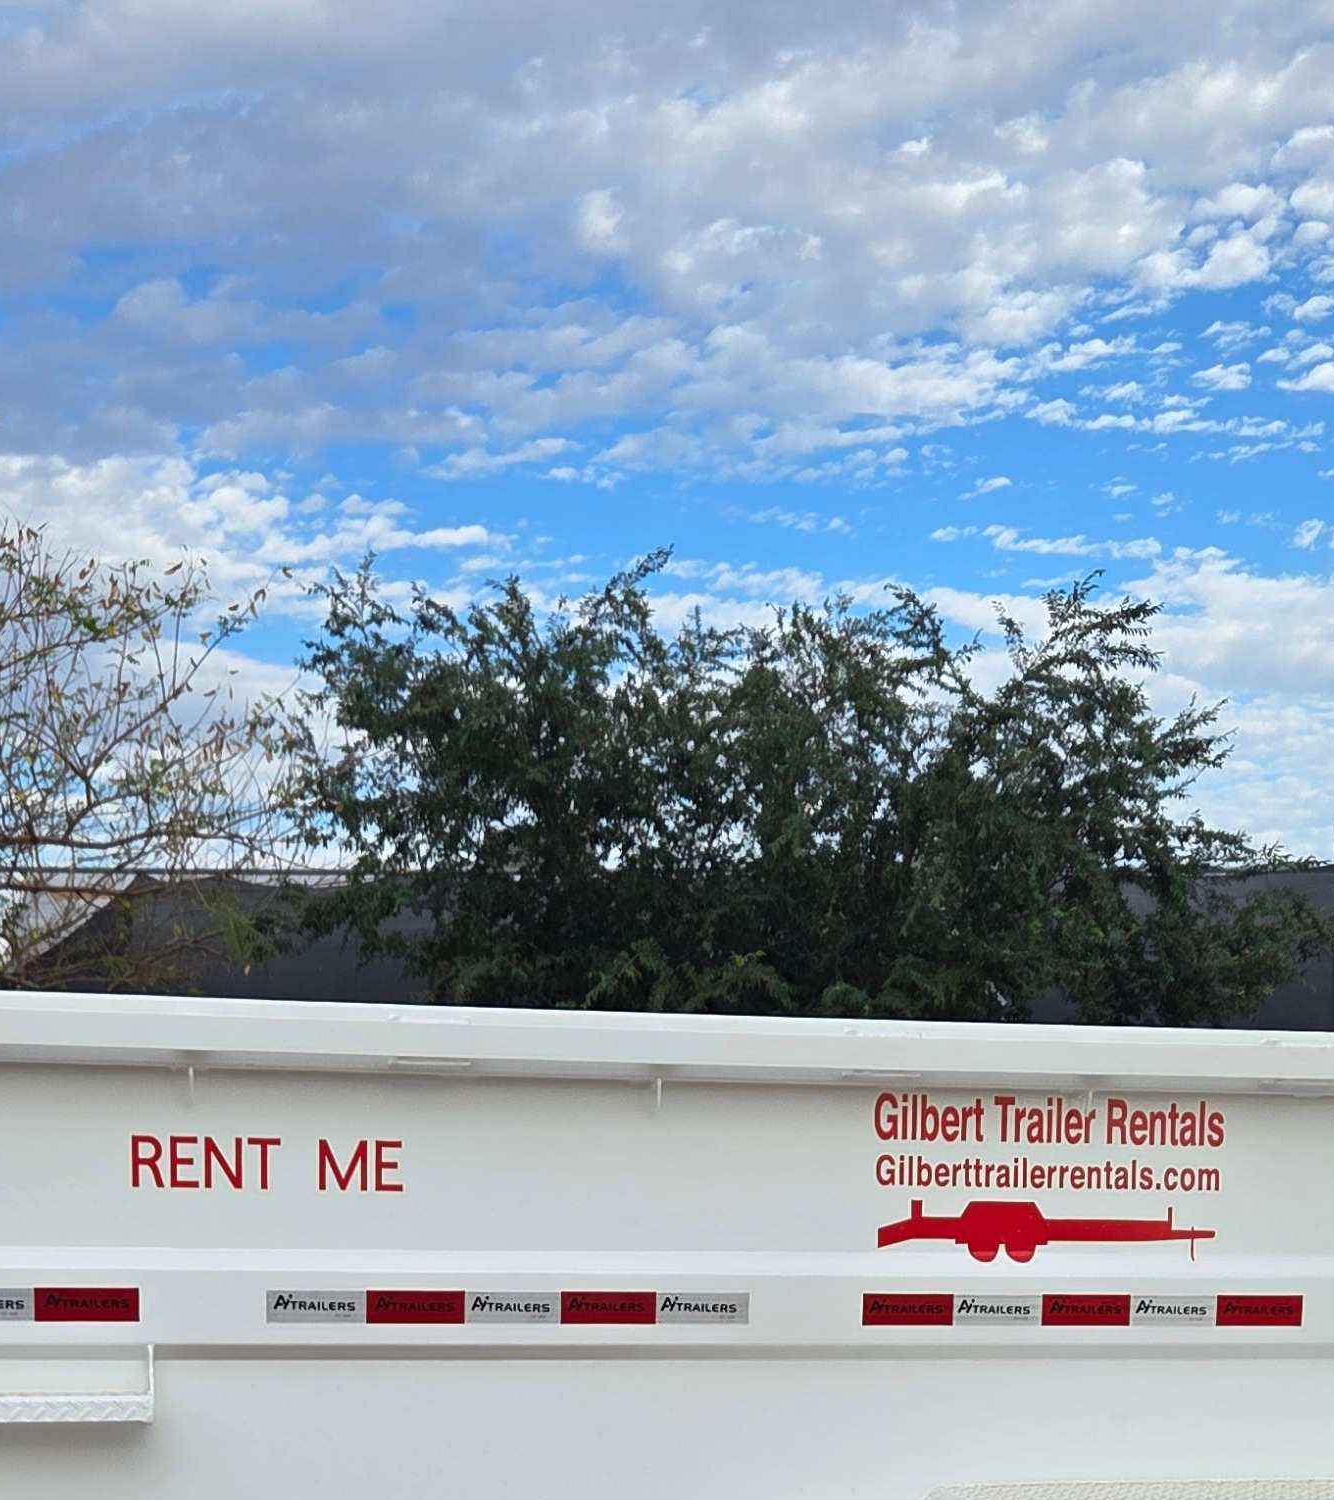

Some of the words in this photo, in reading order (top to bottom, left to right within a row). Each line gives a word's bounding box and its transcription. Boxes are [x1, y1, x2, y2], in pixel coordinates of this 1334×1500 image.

[875, 1094, 983, 1141] Gilbert
[996, 1096, 1094, 1144] Trailer
[1108, 1100, 1223, 1147] Rentals
[131, 1136, 280, 1190] RENT
[319, 1140, 403, 1192] ME
[876, 1155, 1220, 1191] Gilberttrailerrentals.com
